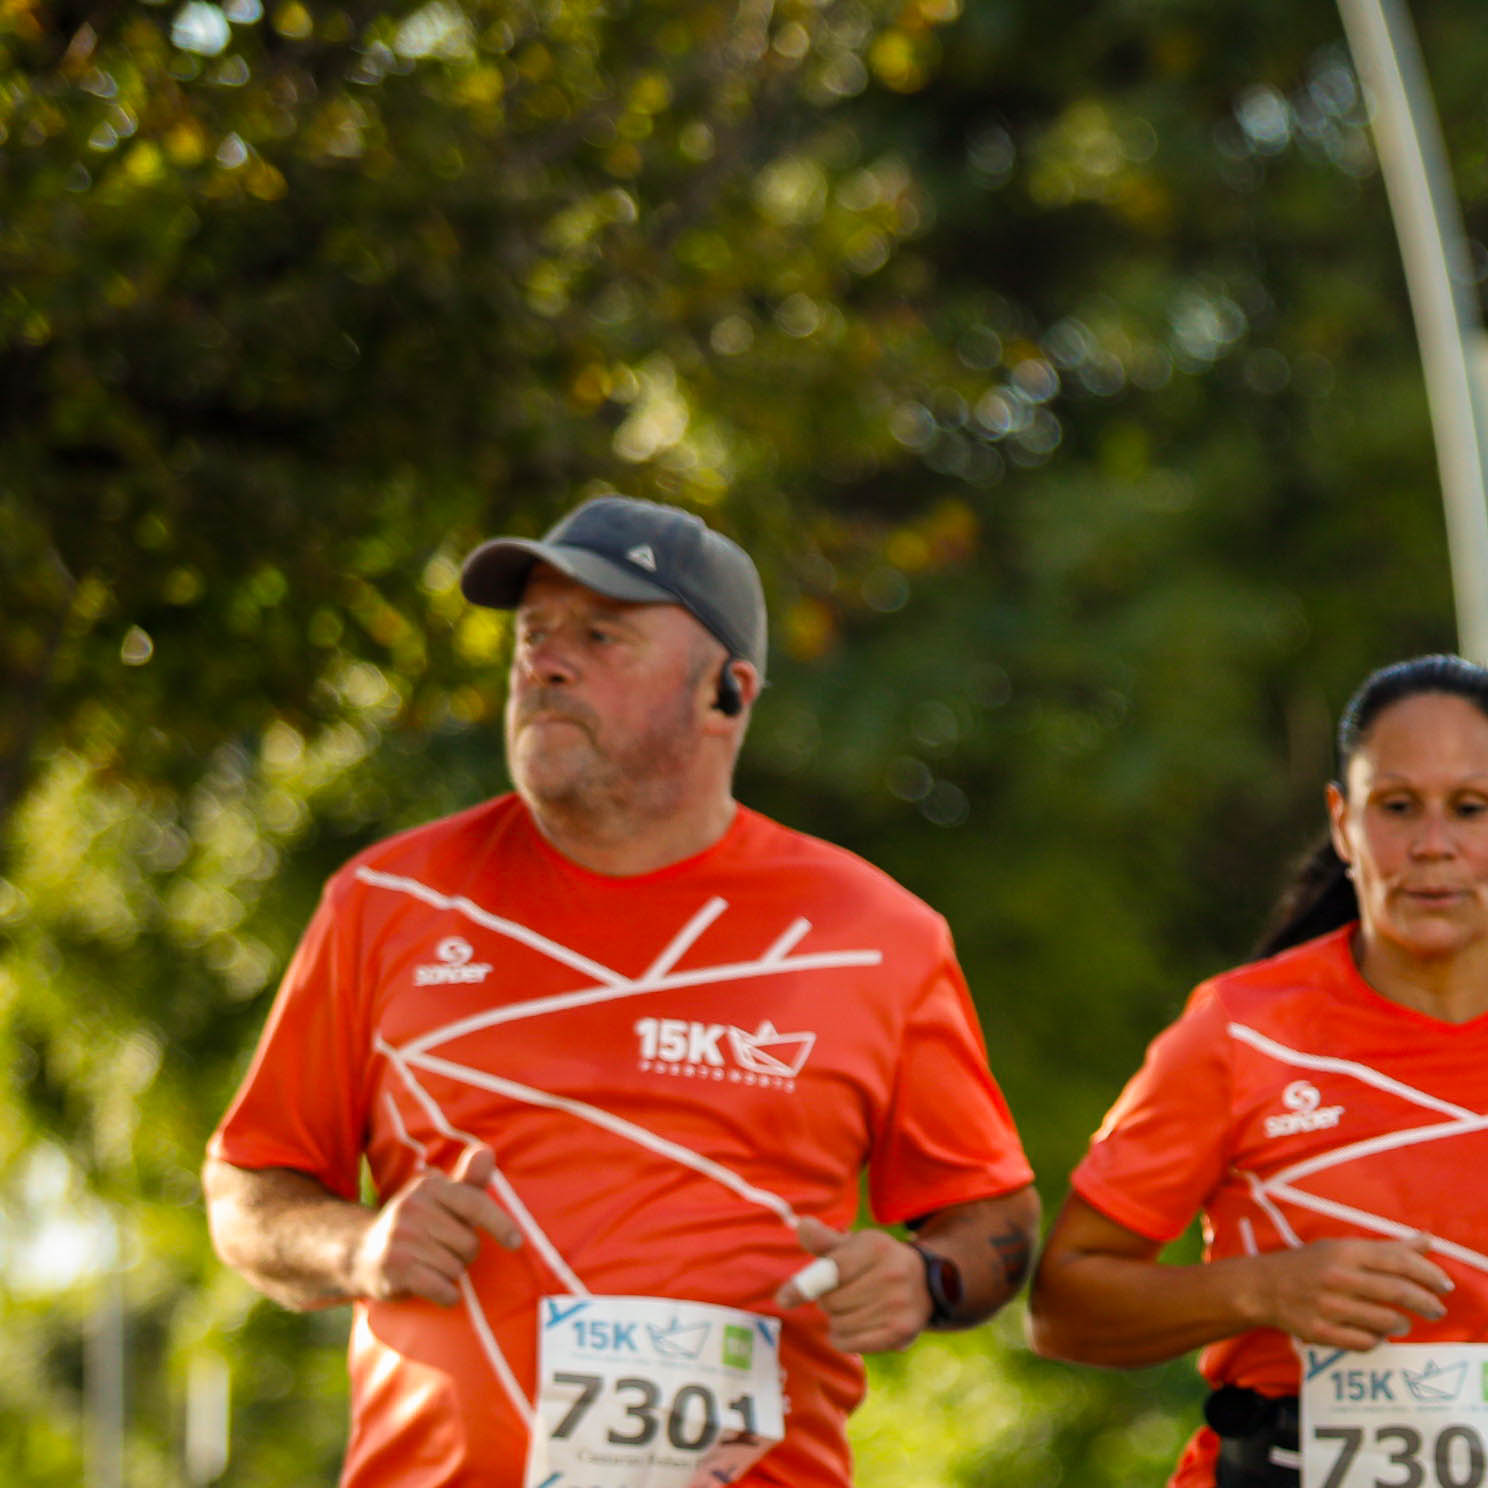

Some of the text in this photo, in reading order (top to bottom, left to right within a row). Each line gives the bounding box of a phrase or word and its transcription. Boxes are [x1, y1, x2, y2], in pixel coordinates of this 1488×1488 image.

[634, 1016, 726, 1067] 15K
[571, 1320, 639, 1353] 15K
[1330, 1370, 1394, 1401] 15K
[551, 1372, 759, 1452] 7301
